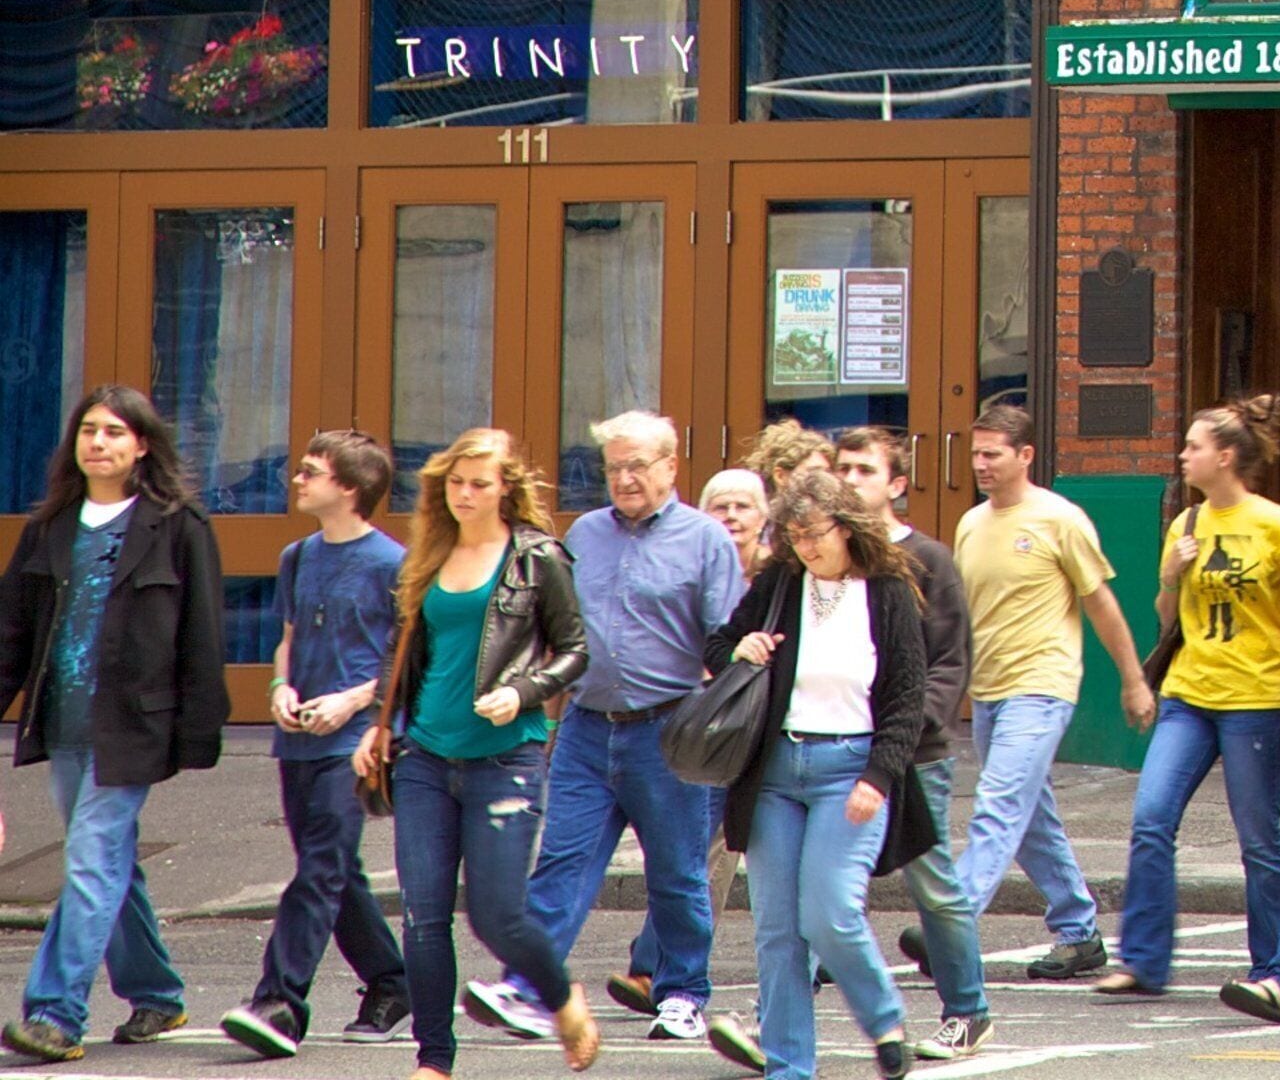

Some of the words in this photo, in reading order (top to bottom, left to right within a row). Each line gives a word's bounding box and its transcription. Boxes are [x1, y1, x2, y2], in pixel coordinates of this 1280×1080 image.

[397, 35, 696, 78] TRINITY
[1056, 40, 1242, 77] Established
[498, 128, 549, 163] 111
[784, 289, 836, 304] DRUNK
